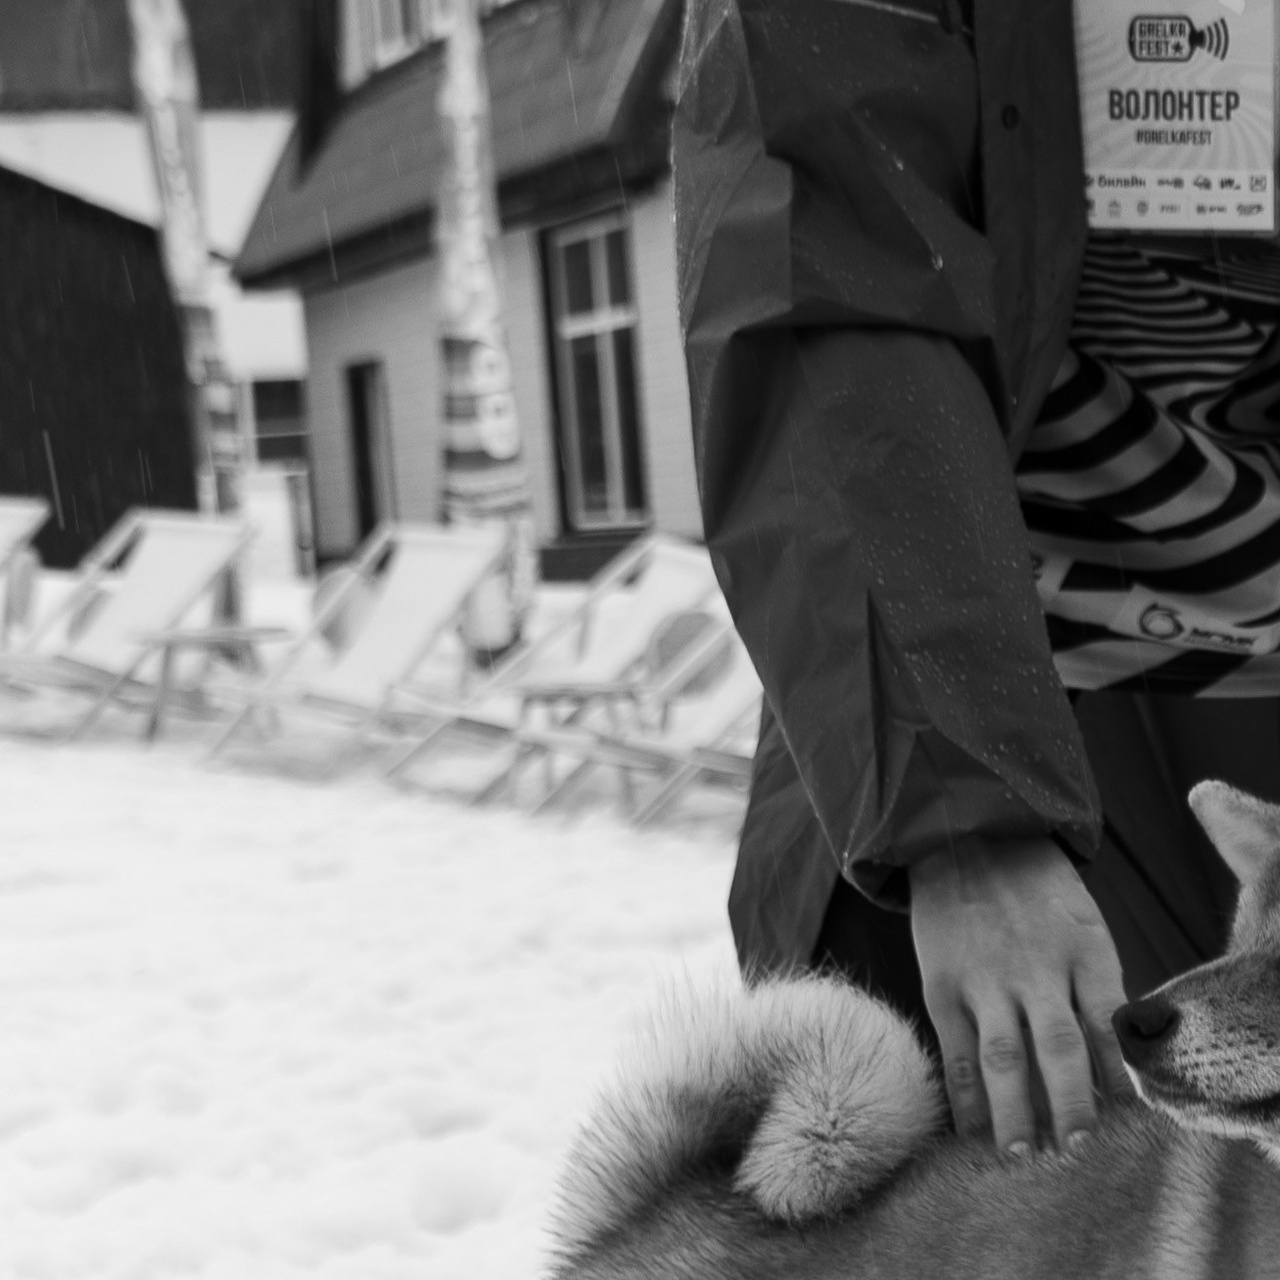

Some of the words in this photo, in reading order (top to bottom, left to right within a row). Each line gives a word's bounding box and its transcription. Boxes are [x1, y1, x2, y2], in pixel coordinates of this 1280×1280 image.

[1138, 21, 1187, 38] GRELKA
[1138, 39, 1169, 56] FEST
[1108, 88, 1240, 121] ВОЛОНТЕР
